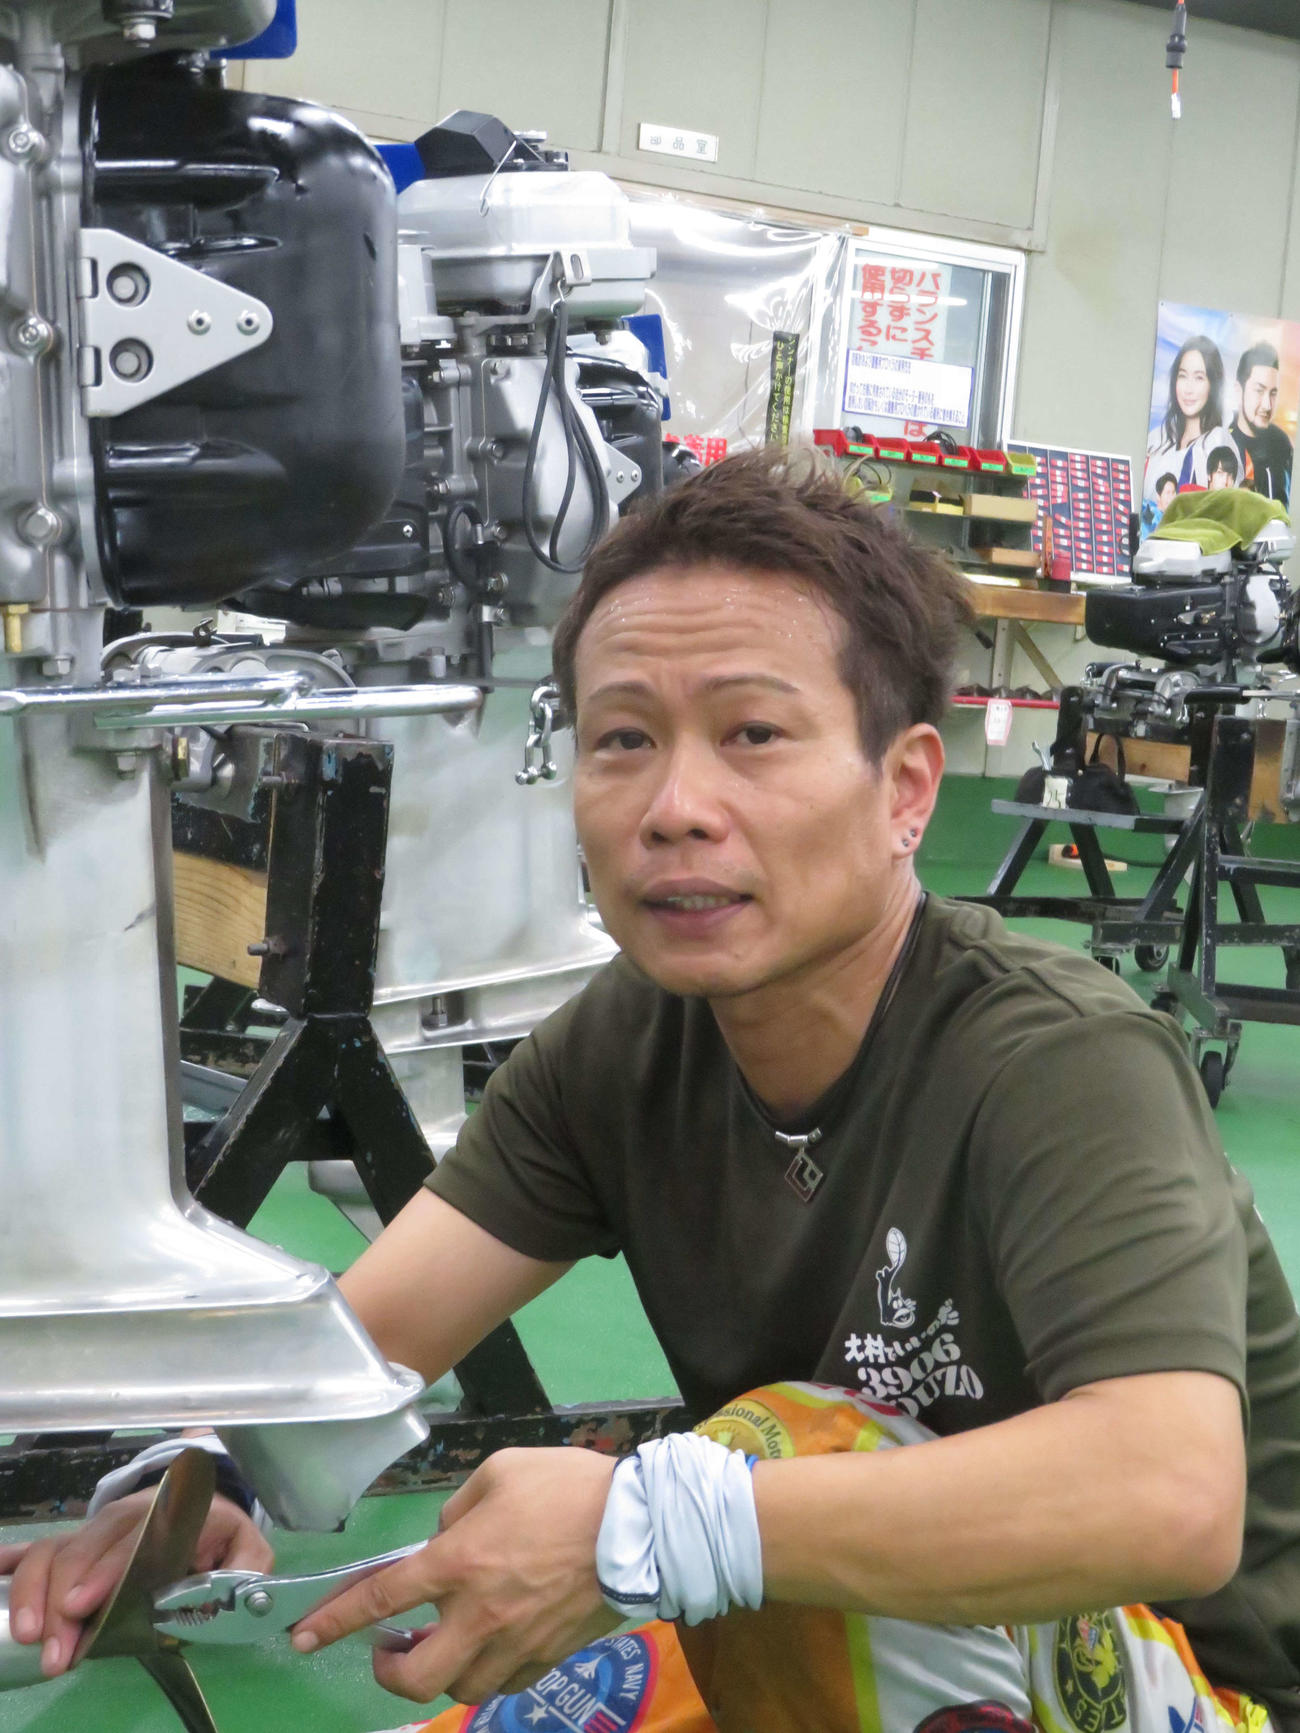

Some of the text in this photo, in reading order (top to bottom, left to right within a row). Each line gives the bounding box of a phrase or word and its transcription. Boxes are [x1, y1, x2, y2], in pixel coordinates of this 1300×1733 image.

[535, 1667, 597, 1726] OP GUN
[619, 1662, 645, 1700] NAVY
